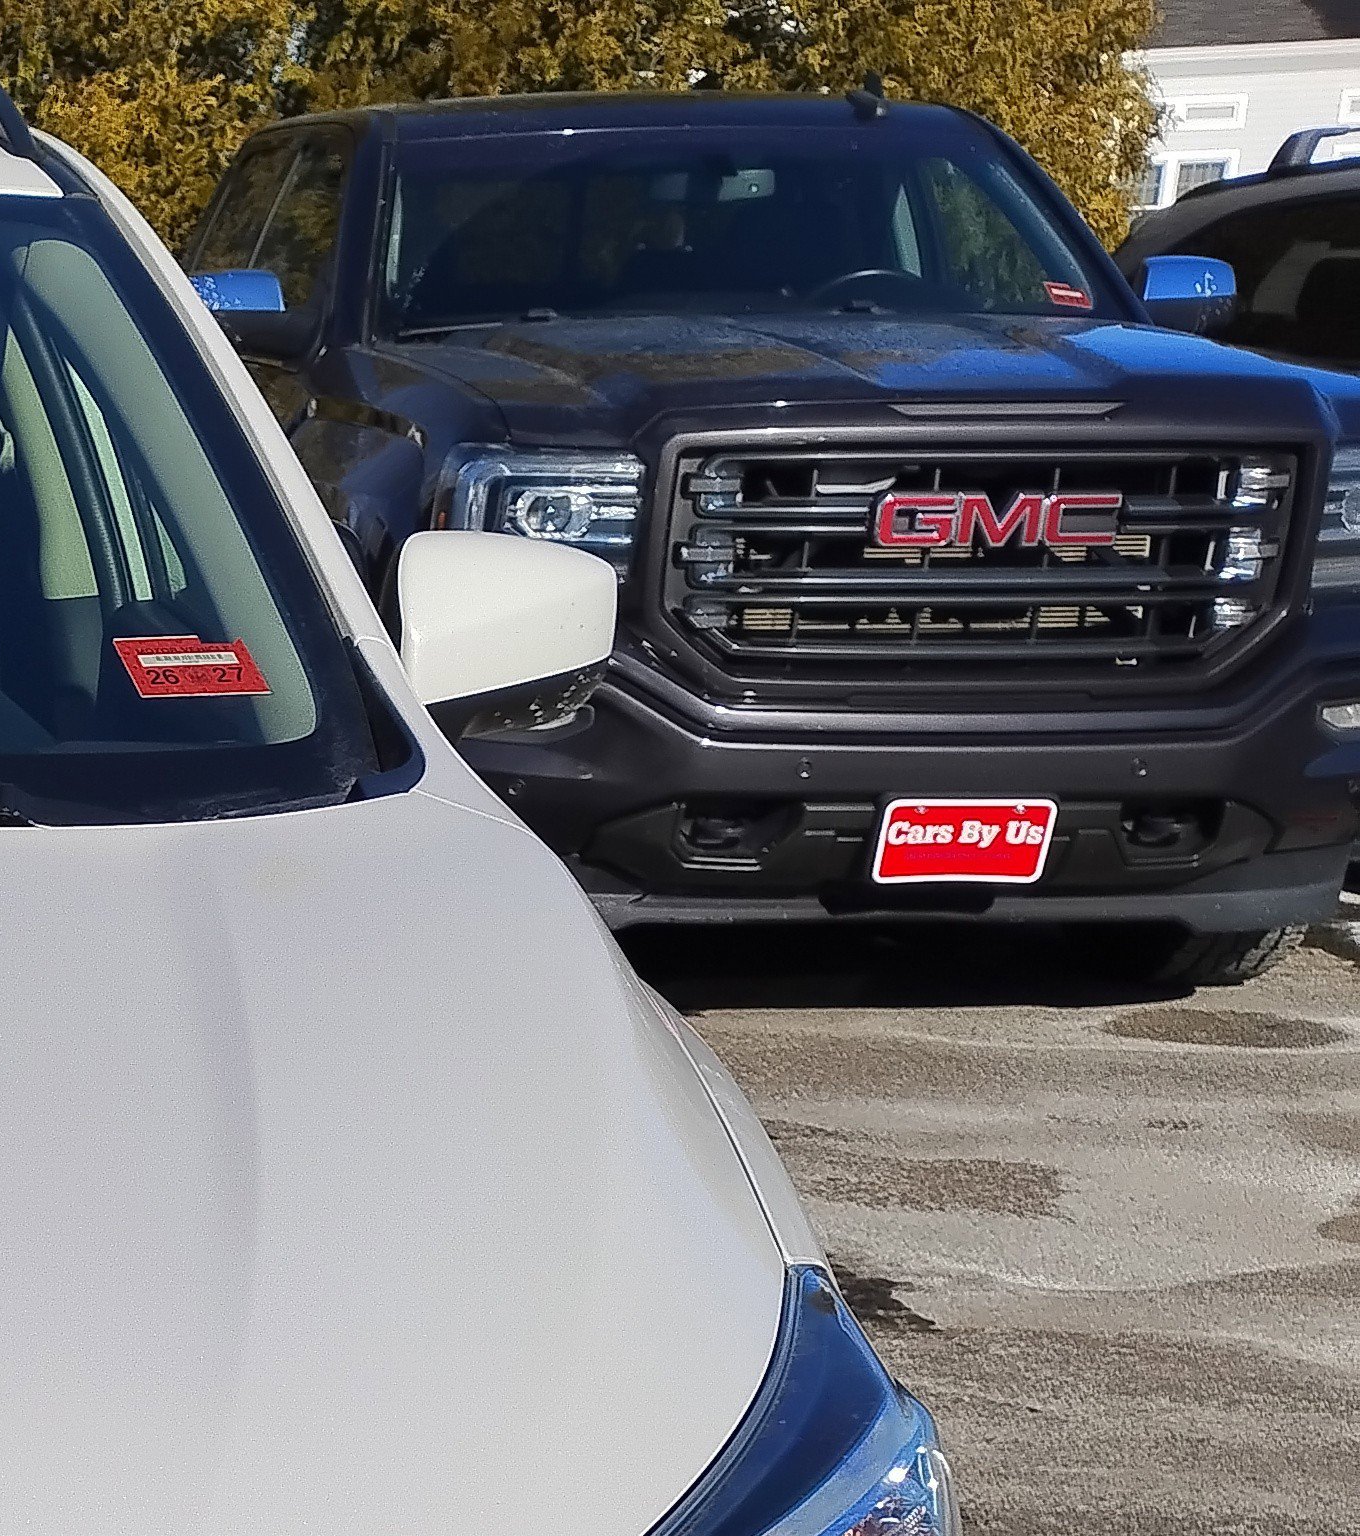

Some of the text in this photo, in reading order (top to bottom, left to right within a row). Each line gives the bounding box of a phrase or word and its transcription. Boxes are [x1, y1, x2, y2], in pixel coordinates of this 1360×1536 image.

[876, 491, 1123, 547] GMC
[145, 666, 244, 685] 26 27
[887, 820, 1044, 849] Cars By Us
